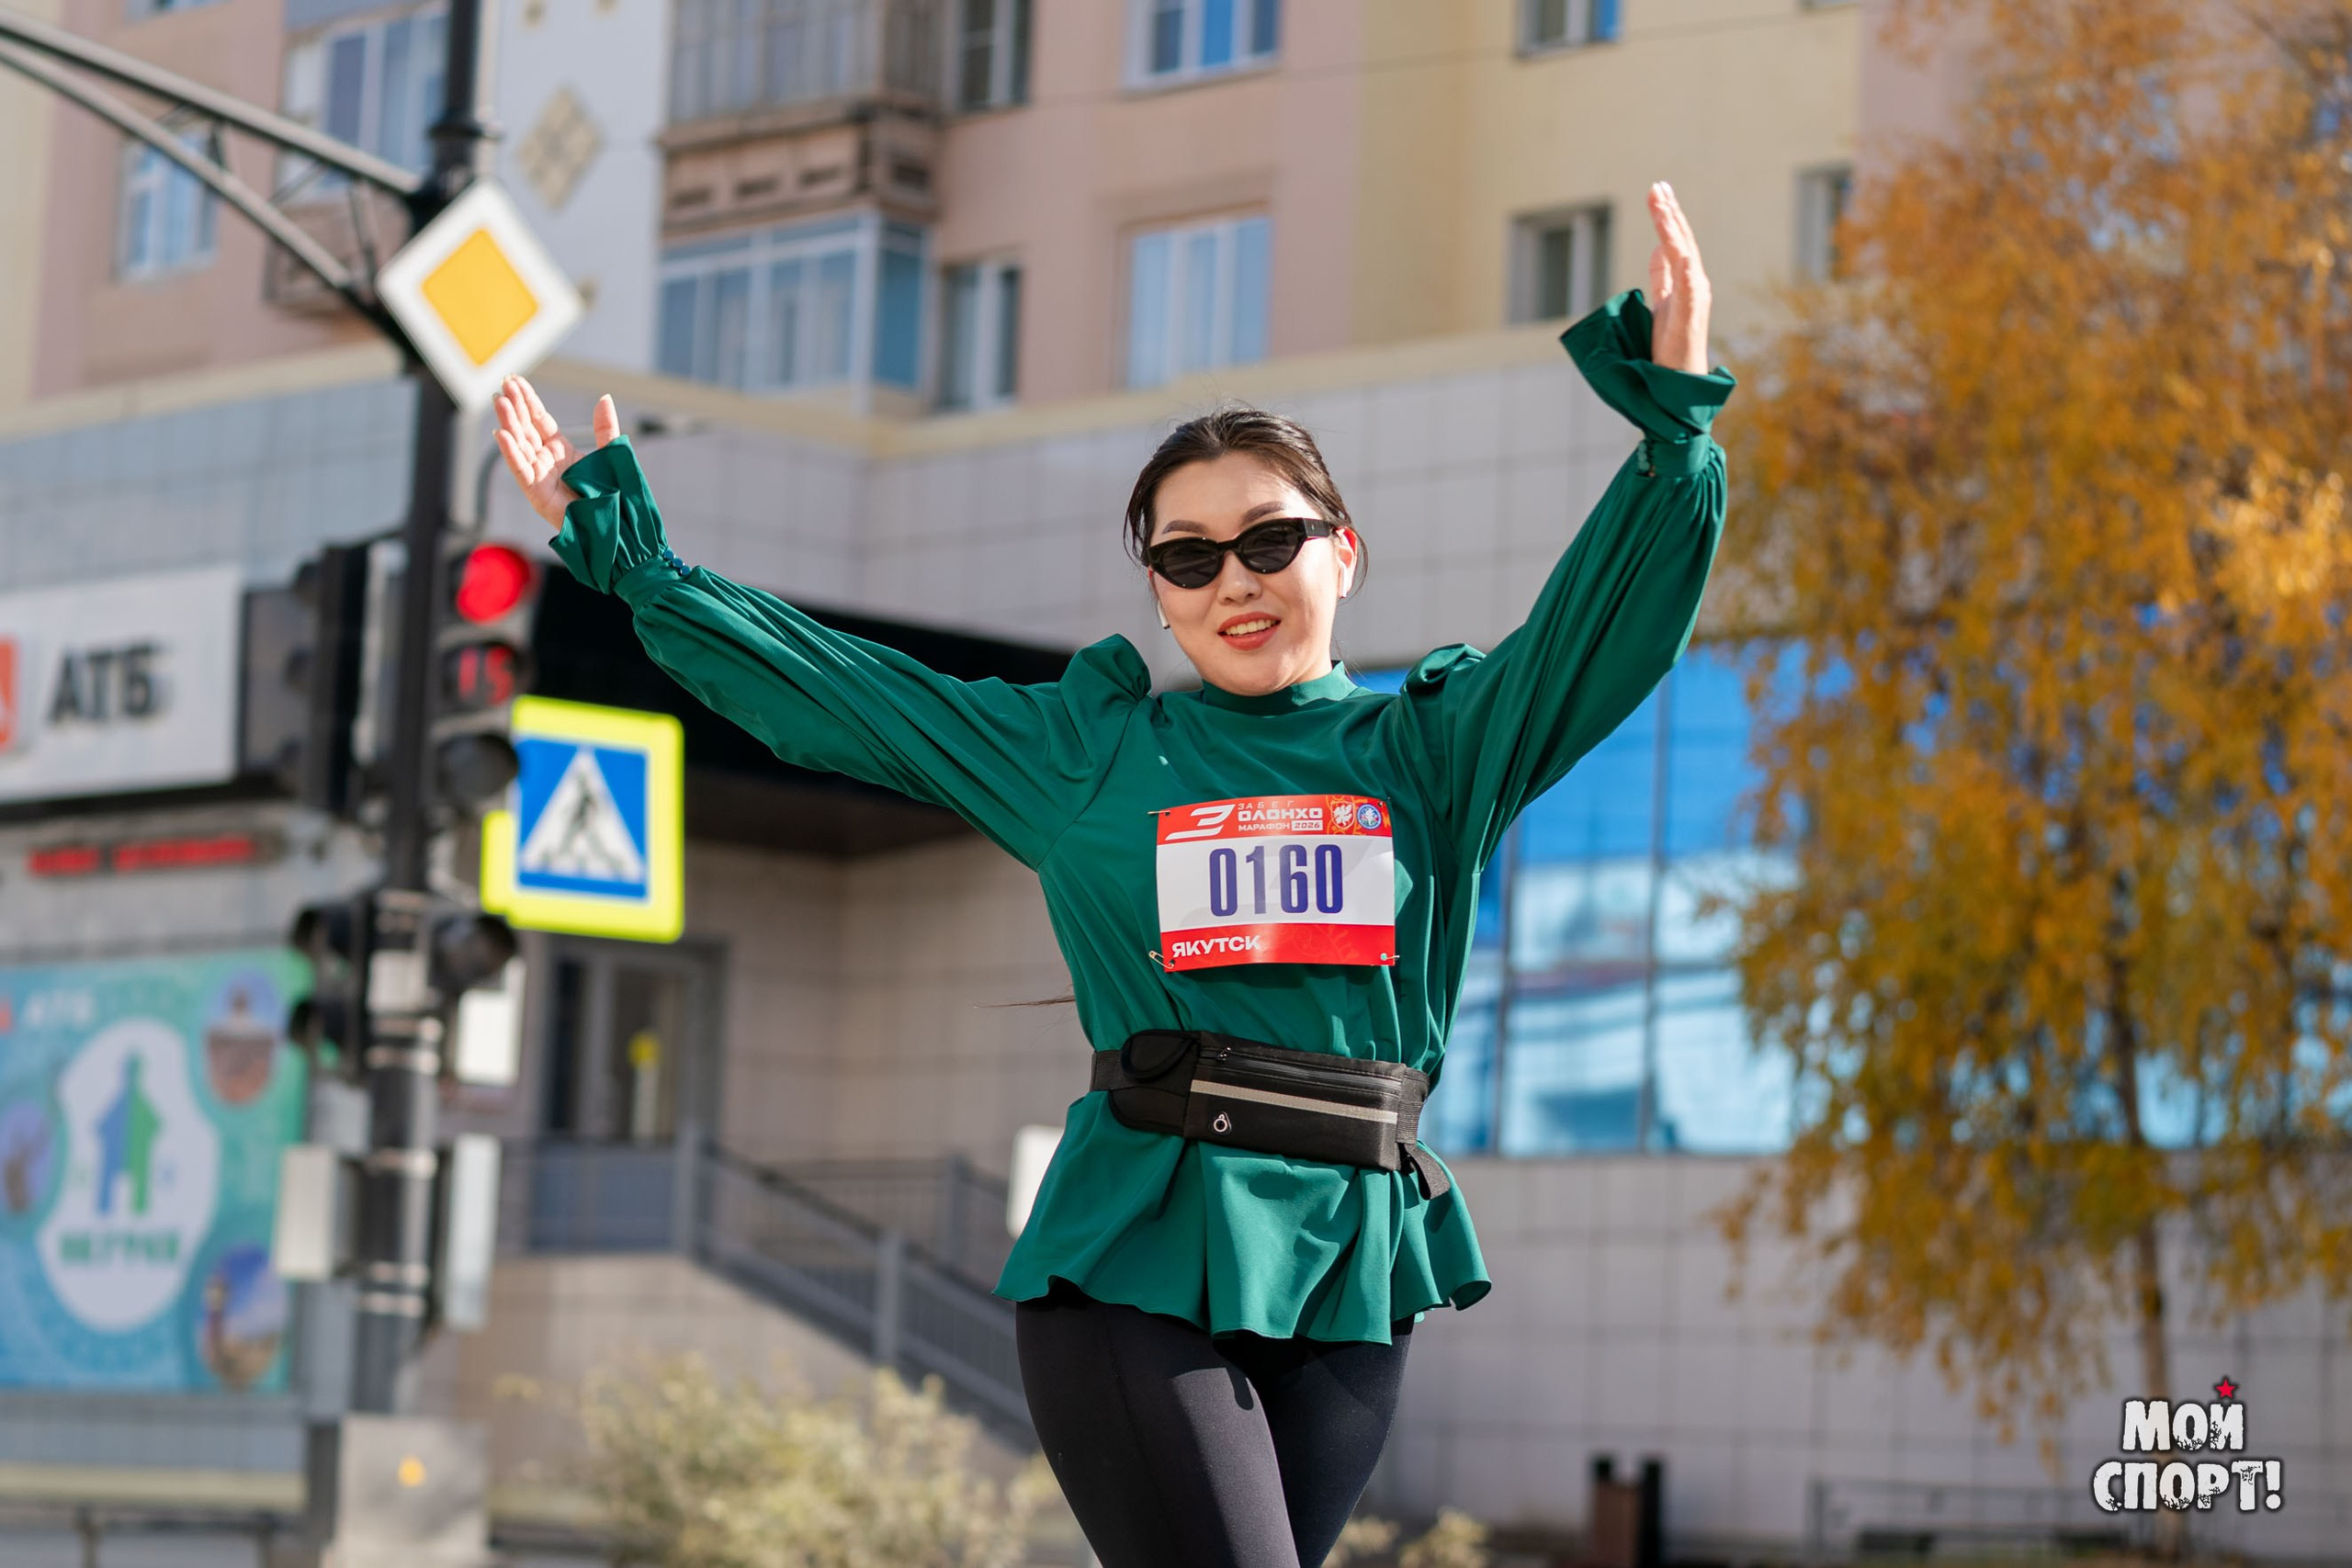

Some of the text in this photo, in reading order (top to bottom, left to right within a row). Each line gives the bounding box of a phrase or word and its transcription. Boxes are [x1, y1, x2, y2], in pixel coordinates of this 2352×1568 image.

[48, 643, 164, 724] АТБ
[1238, 800, 1294, 810] ЗАБЕГ
[1238, 807, 1323, 822] ОЛОНХО
[1238, 822, 1291, 831] МАРАФОН
[1209, 844, 1343, 917] 0160
[1171, 935, 1260, 958] ЯКУТСК
